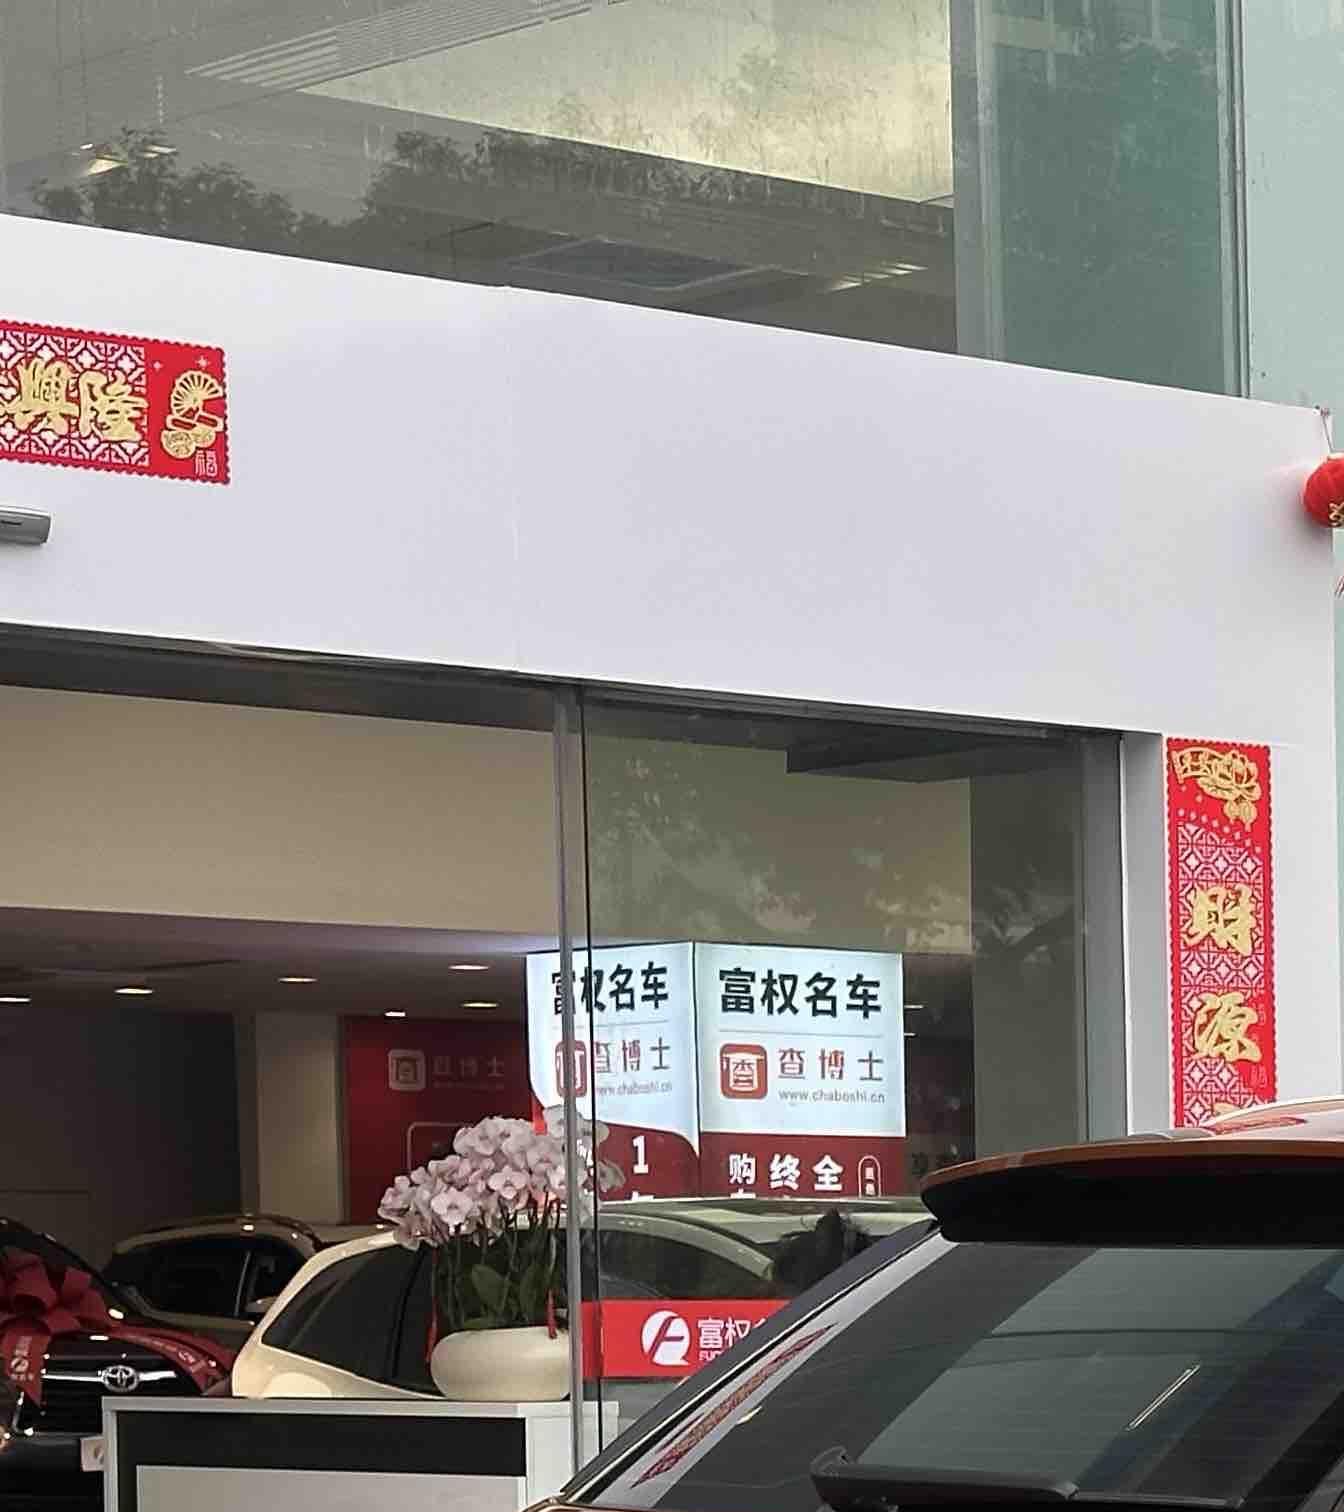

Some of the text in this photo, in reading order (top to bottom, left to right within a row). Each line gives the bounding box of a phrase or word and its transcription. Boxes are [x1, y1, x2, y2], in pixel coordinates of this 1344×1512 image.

[719, 967, 882, 1020] 富权名车
[777, 1048, 884, 1082] 查博士
[778, 1087, 886, 1105] www.chaboshi.cn
[698, 1316, 766, 1349] 富权
